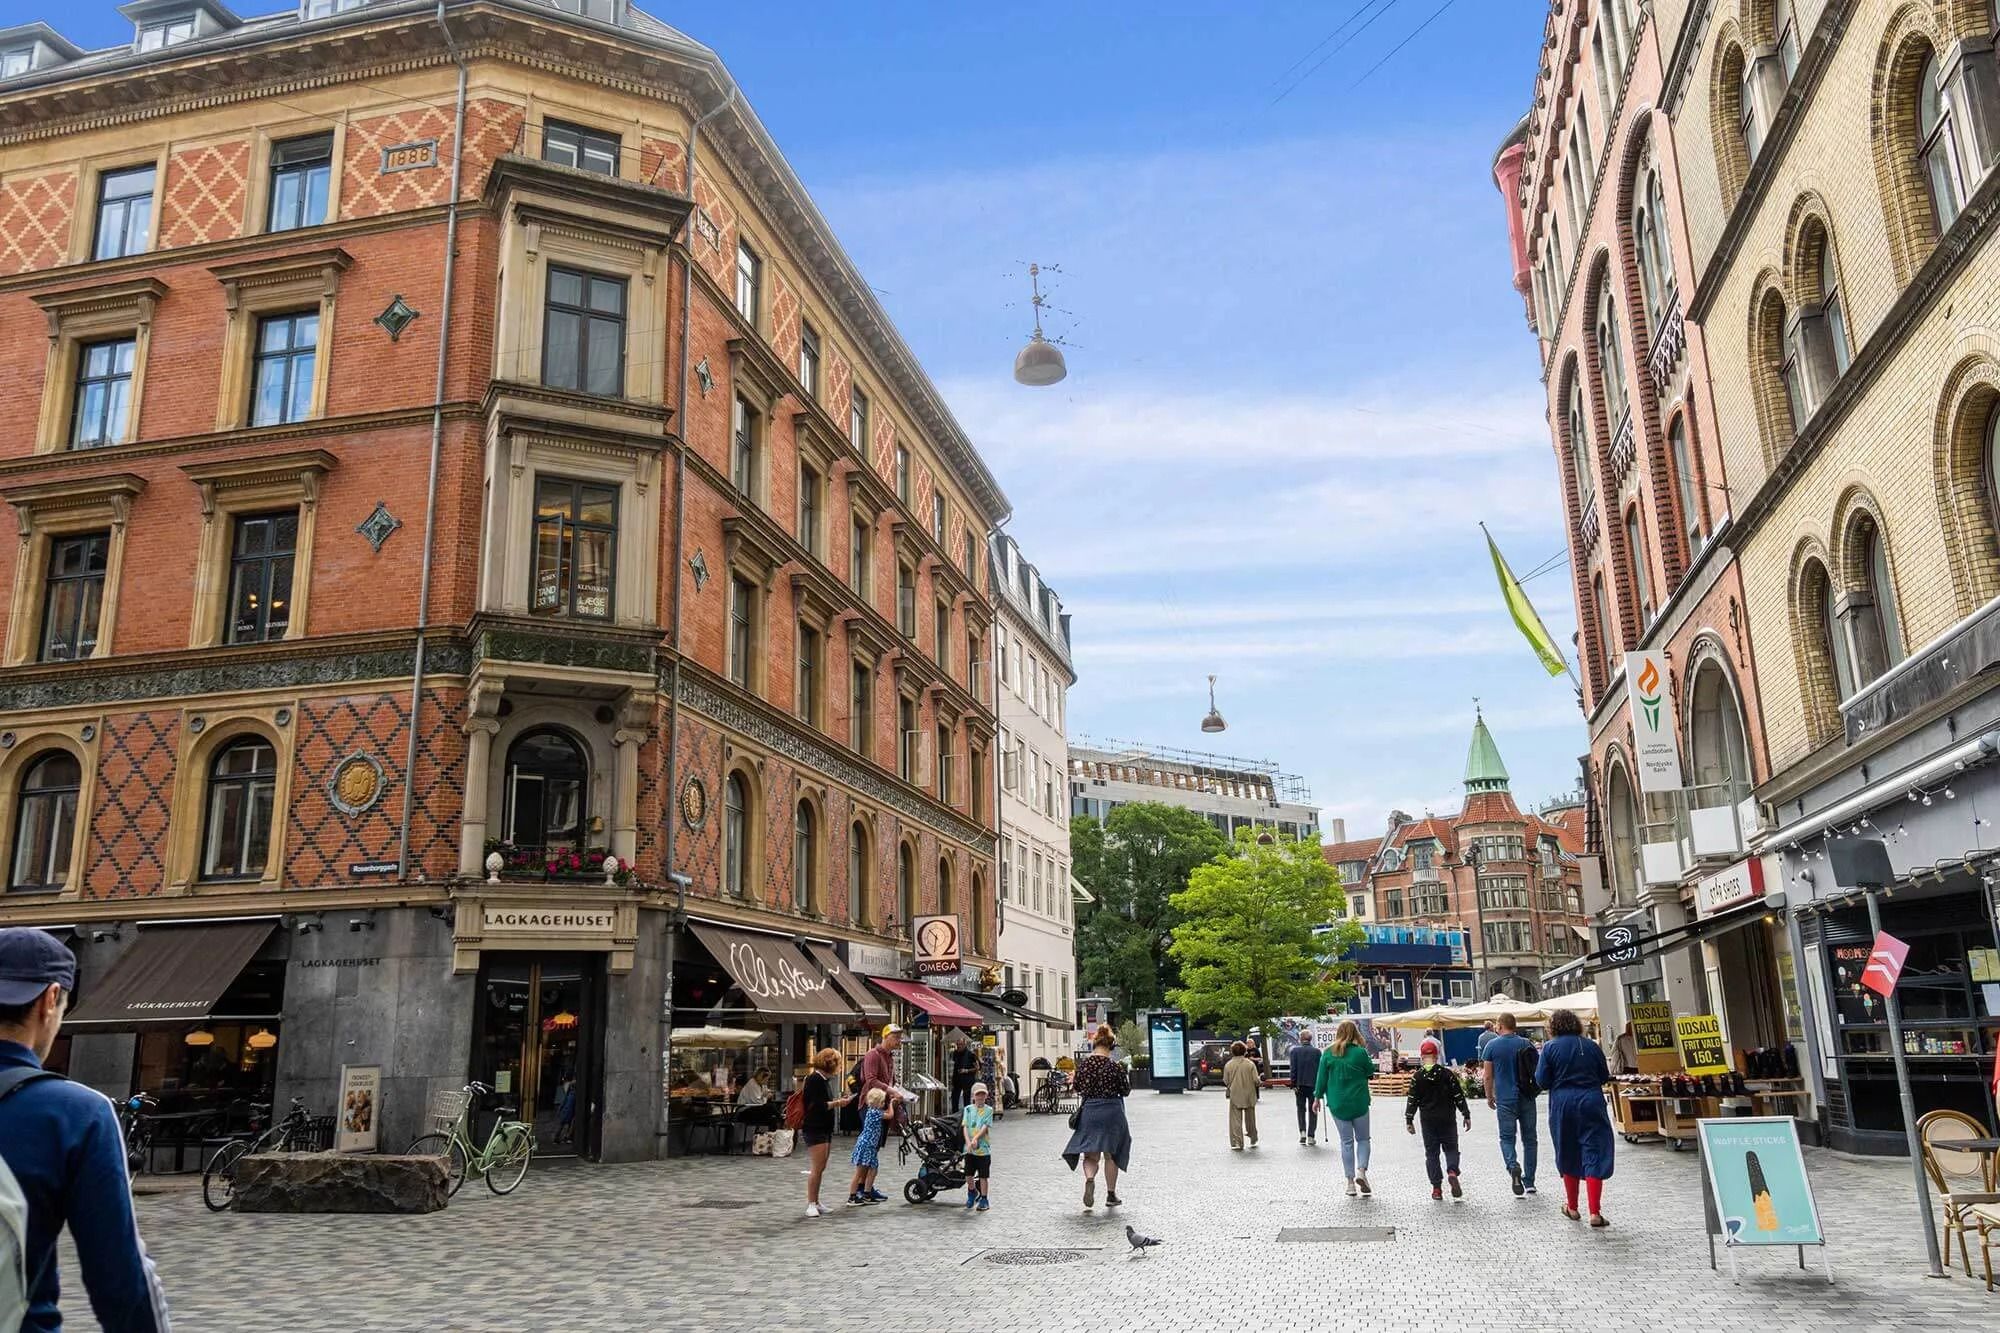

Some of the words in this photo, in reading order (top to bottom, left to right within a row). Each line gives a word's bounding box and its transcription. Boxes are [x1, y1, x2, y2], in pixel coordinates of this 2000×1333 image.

[390, 147, 429, 167] 1888
[484, 914, 613, 926] LAGKAGEHUSET
[301, 957, 381, 968] LAGKAGEHUSET
[918, 962, 958, 973] OMEGA
[126, 1000, 210, 1009] LAGKAGEHUSET
[1630, 1006, 1669, 1020] UDSALG
[1636, 1024, 1651, 1033] FRIT
[1653, 1022, 1670, 1032] VALG
[1678, 1020, 1719, 1036] UDSALG
[1684, 1039, 1699, 1050] FRIT
[1702, 1038, 1721, 1049] VALG
